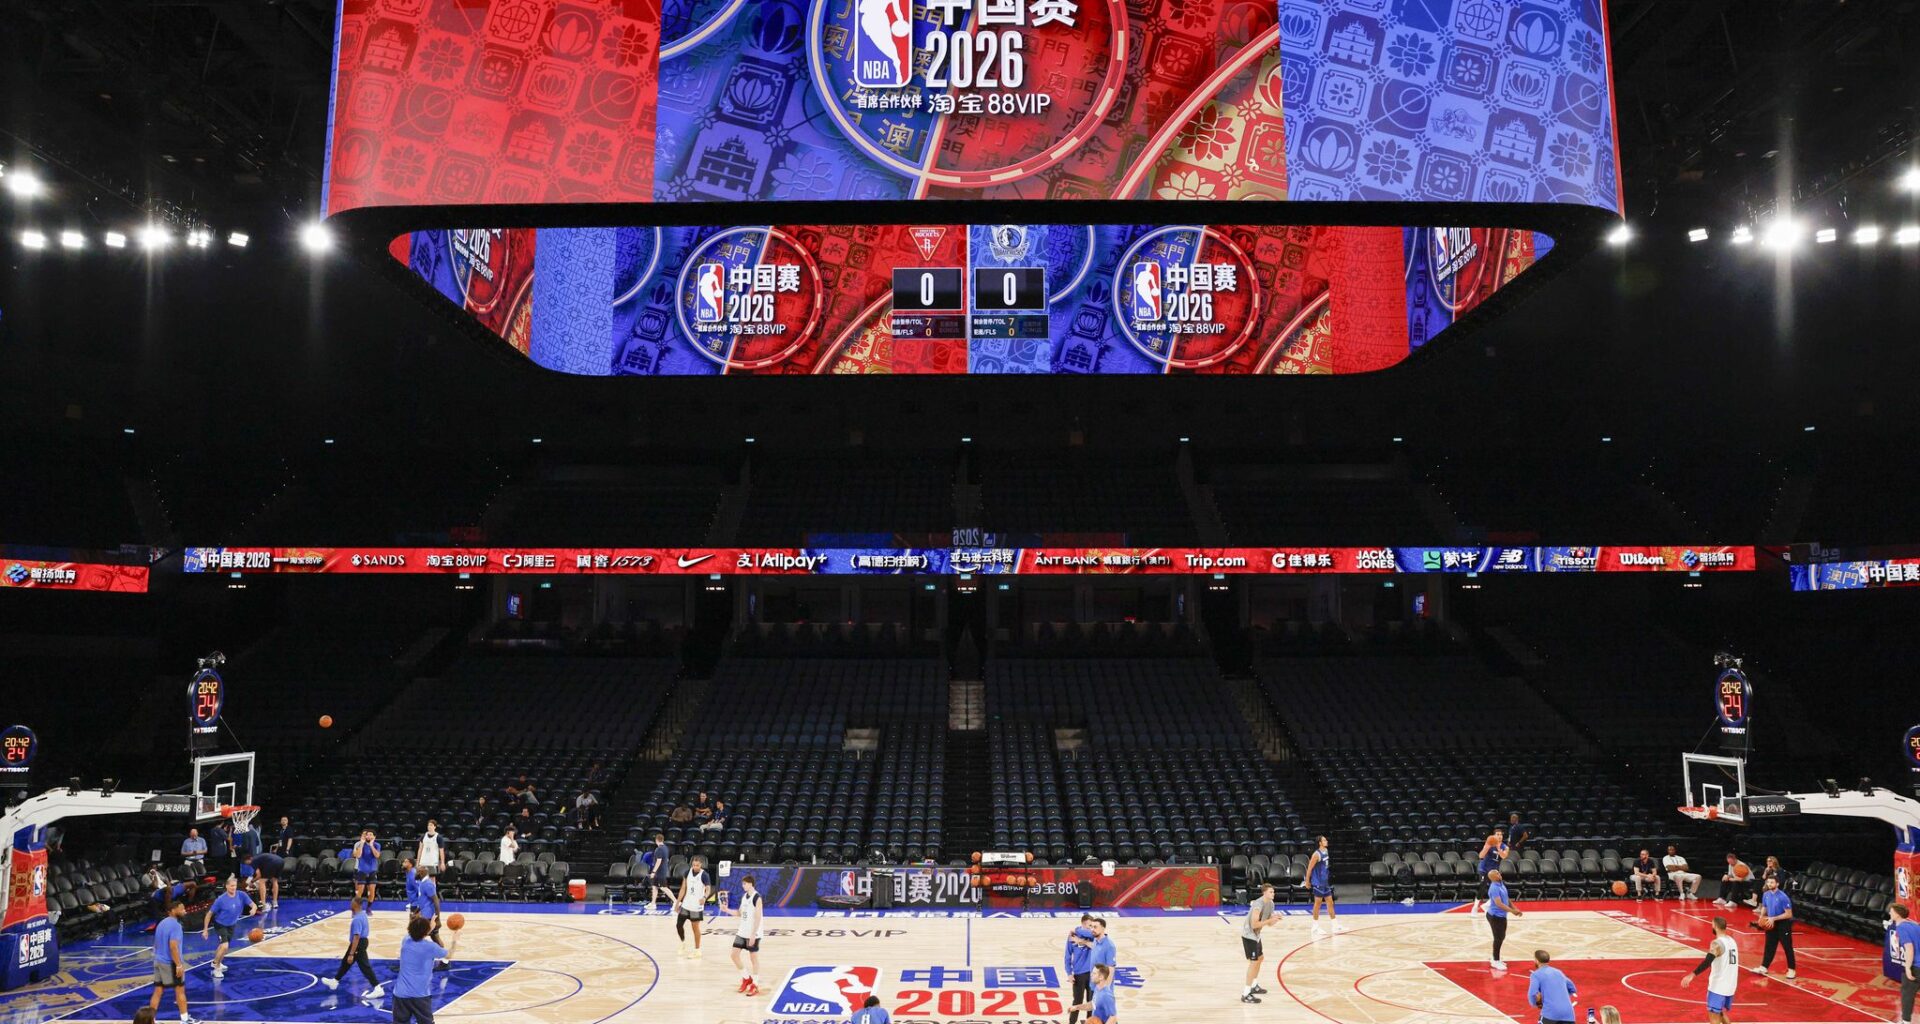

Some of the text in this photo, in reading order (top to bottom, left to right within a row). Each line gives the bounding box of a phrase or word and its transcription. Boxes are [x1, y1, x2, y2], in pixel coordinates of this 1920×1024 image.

[926, 30, 1023, 88] 2026
[863, 61, 890, 80] NBA
[857, 94, 922, 109] 首席合作伙伴
[730, 264, 800, 293] 中国赛
[1166, 263, 1237, 292] 中国赛
[920, 272, 934, 306] 0
[1003, 272, 1017, 306] 0
[700, 308, 713, 318] NBA
[729, 294, 774, 323] 2026
[1138, 306, 1152, 317] NBA
[1167, 293, 1212, 322] 2026
[925, 318, 932, 326] 7
[1008, 317, 1015, 326] 7
[925, 328, 932, 337] 0
[1008, 328, 1015, 337] 0
[363, 555, 405, 566] SANDS
[523, 555, 555, 567] 阿里云
[950, 552, 1013, 563] 亚马逊云科技
[1063, 556, 1098, 565] BANK
[1185, 554, 1246, 568] Trip.com
[1288, 553, 1332, 568] 佳得乐
[1356, 550, 1395, 560] JACK&
[1443, 551, 1478, 569] 蒙牛
[1619, 553, 1665, 566] Wilson
[1356, 559, 1395, 569] JONES
[1558, 557, 1596, 566] TISSOT
[1869, 564, 1920, 583] 中国赛
[198, 682, 218, 694] 20:42
[1721, 682, 1742, 694] 20:42
[198, 695, 216, 717] 24
[1724, 695, 1742, 717] 24
[4, 737, 30, 747] 20:42
[7, 748, 25, 760] 24
[290, 909, 335, 927] 1573
[781, 1001, 831, 1013] NBA
[893, 989, 1064, 1016] 2026
